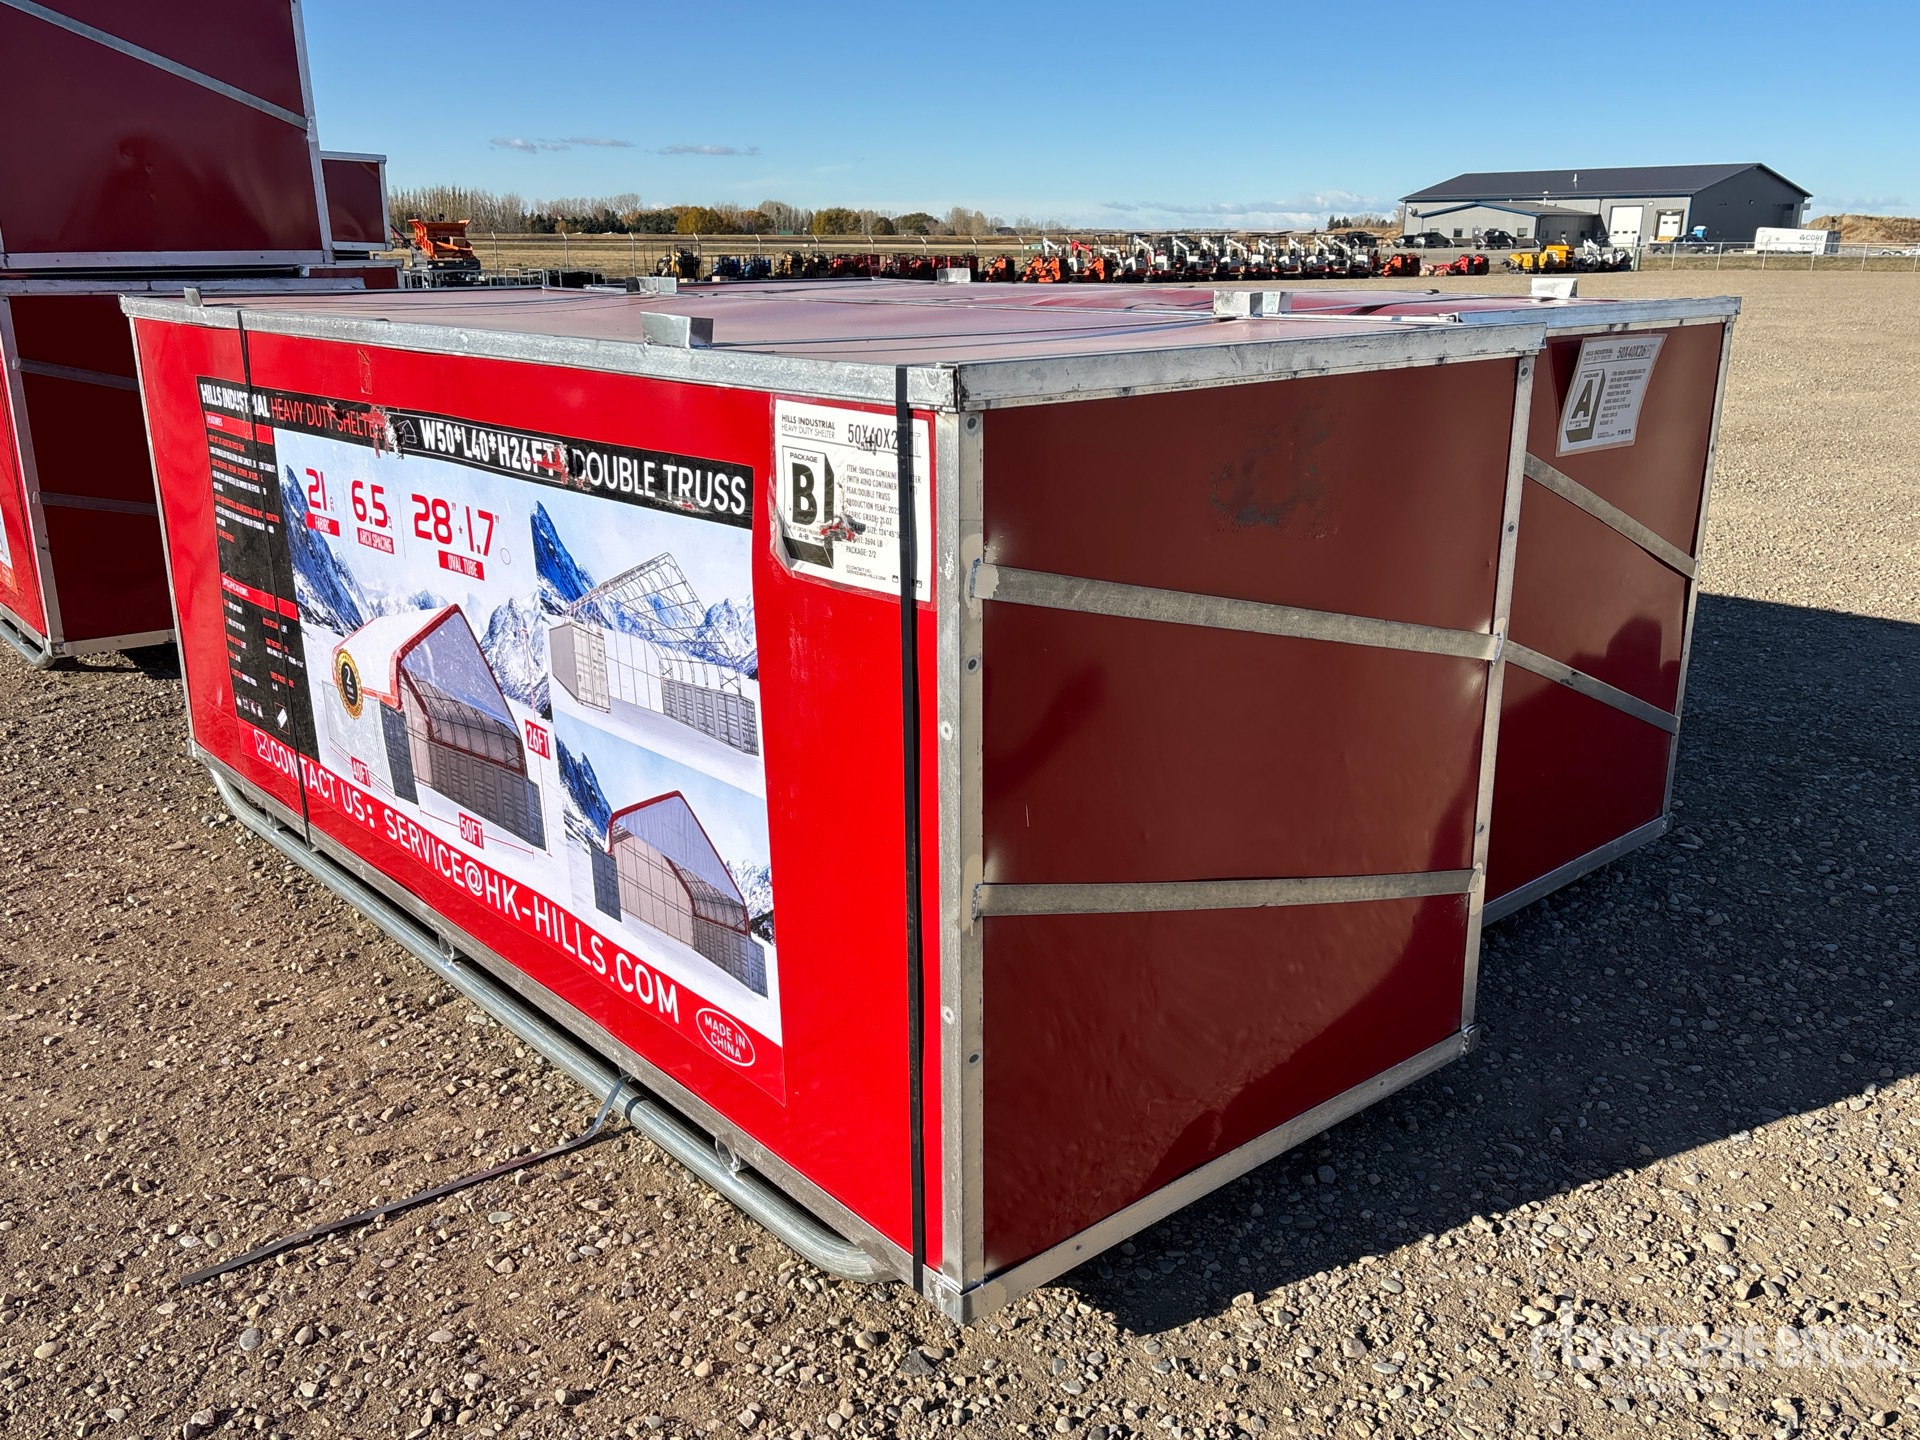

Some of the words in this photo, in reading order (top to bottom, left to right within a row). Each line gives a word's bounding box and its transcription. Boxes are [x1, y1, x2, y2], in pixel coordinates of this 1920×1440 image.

[200, 383, 222, 407] HILLS
[270, 397, 303, 424] HEAVY
[305, 402, 334, 430] DUTY
[1571, 379, 1594, 419] A
[781, 414, 797, 425] HILLS
[798, 416, 836, 430] INDUSTRIAL
[781, 423, 798, 432] HEAVY
[798, 425, 814, 435] DUTY
[814, 427, 836, 439] SHELTER
[789, 452, 818, 463] PACKAGE
[305, 468, 328, 511] 21
[571, 448, 656, 499] DOUBLE
[663, 464, 747, 515] TRUSS
[875, 469, 898, 480] CONTAINE
[351, 479, 388, 528] 6.5
[791, 462, 818, 526] B
[371, 533, 394, 553] SPACING
[447, 554, 463, 572] OVAL
[462, 558, 479, 577] TUBE
[344, 665, 352, 685] 2
[527, 723, 550, 758] 26FT
[459, 816, 483, 847] 50FT
[270, 740, 336, 804] CONTACT
[340, 782, 376, 828] US:
[383, 808, 680, 1024] SERVICE@HK-HILLS.COM
[704, 1013, 733, 1041] MADE
[735, 1032, 746, 1050] IN
[710, 1031, 742, 1061] CHINA
